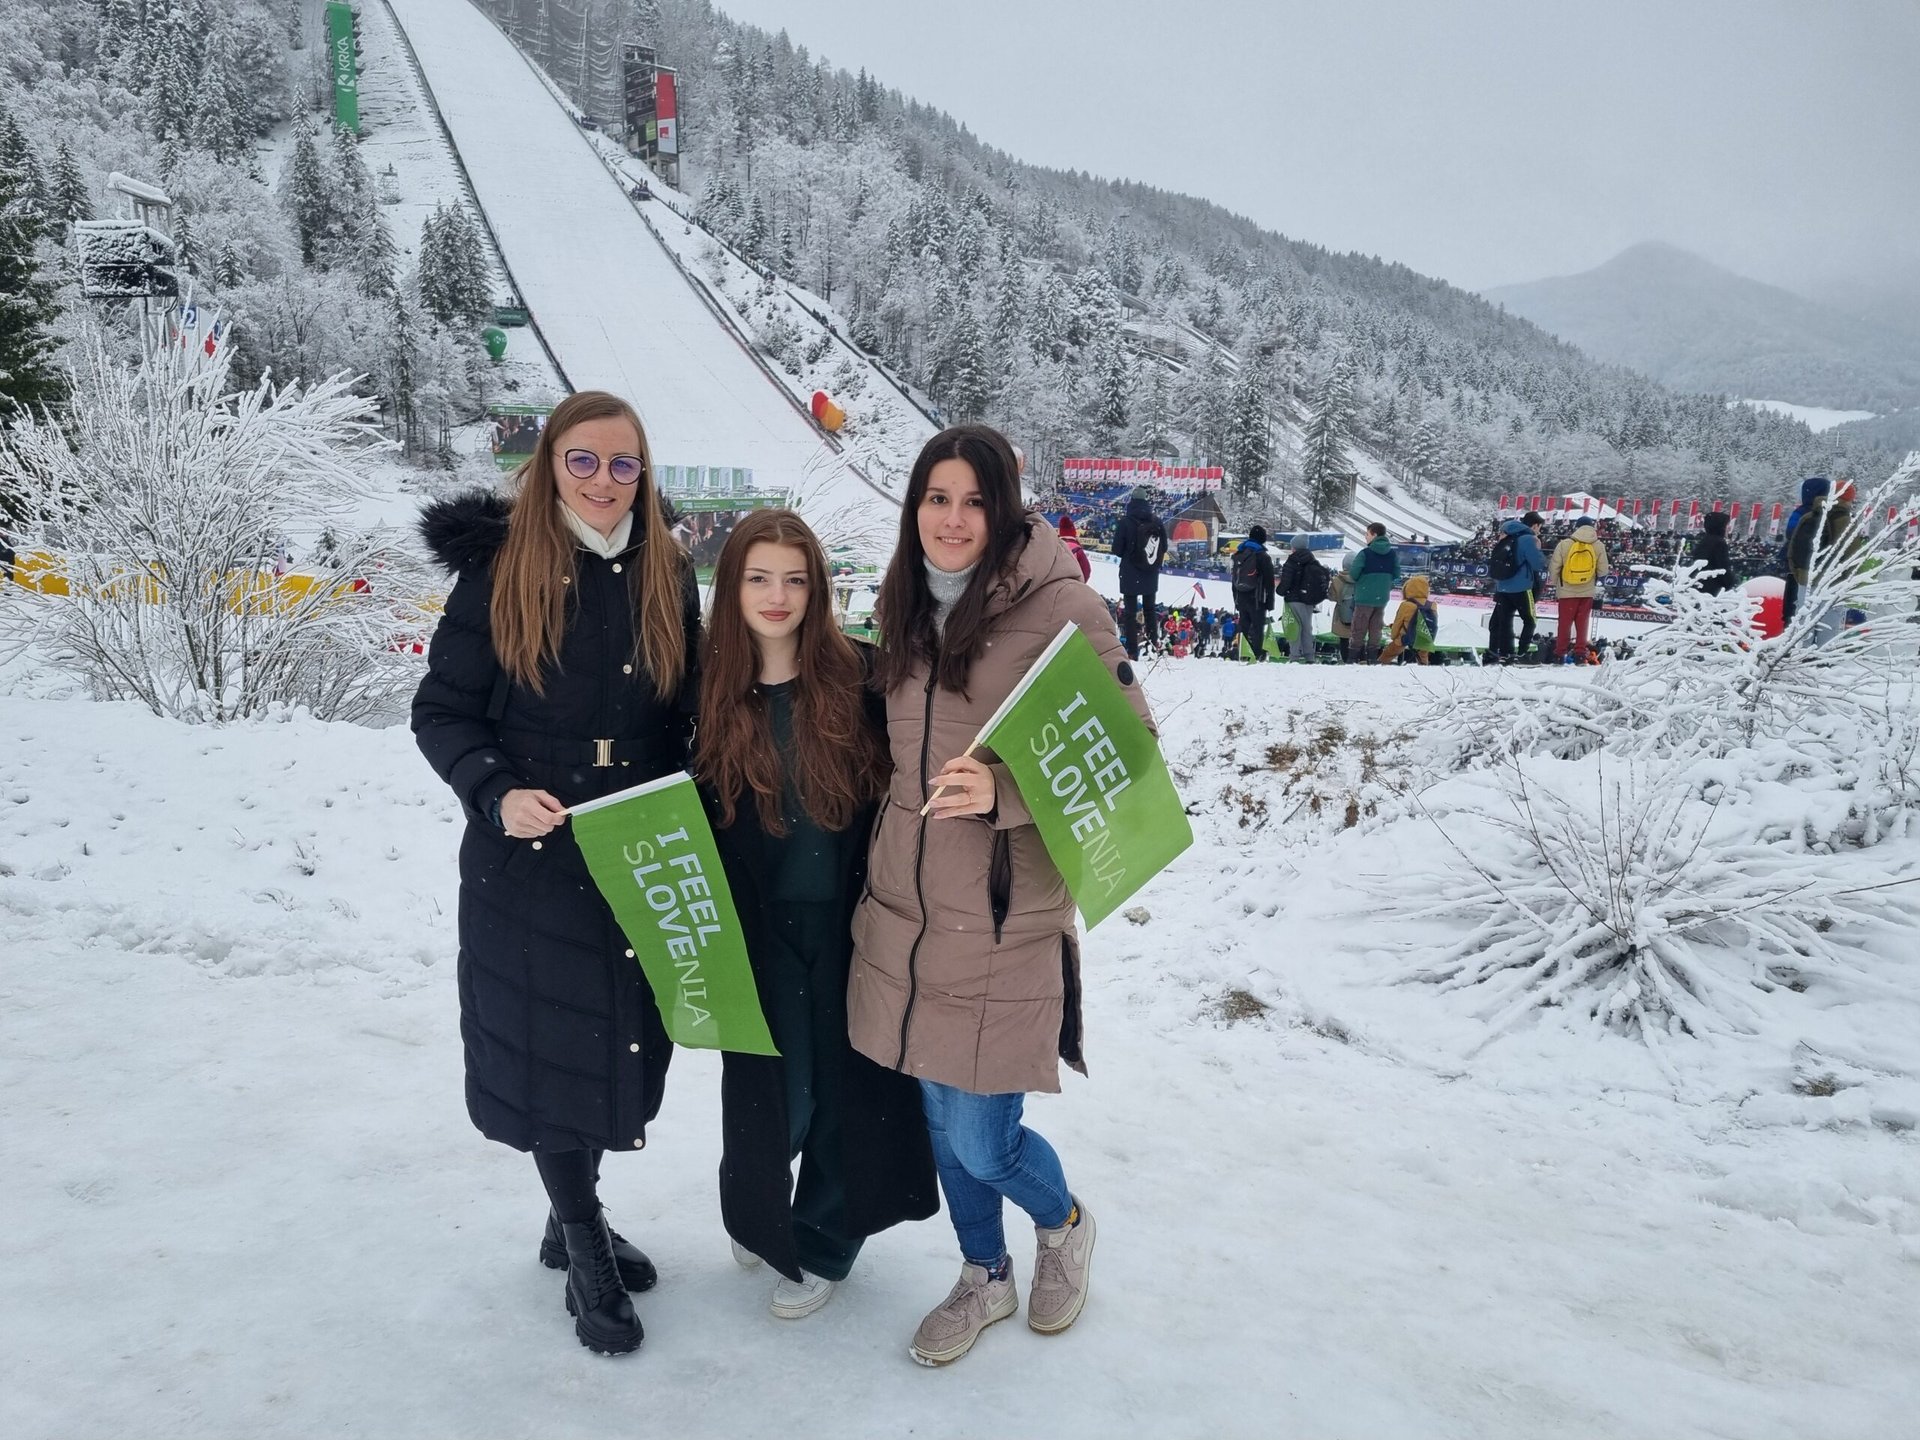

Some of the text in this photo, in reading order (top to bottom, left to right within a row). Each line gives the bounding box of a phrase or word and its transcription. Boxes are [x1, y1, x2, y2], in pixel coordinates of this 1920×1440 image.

[337, 36, 351, 71] KRKA
[1453, 564, 1465, 572] NLB
[1623, 578, 1638, 587] NLB
[1030, 722, 1127, 898] SLOVENIA
[1057, 690, 1132, 812] I FEEL
[623, 840, 712, 1027] SLOVENIA
[655, 826, 721, 948] I FEEL
